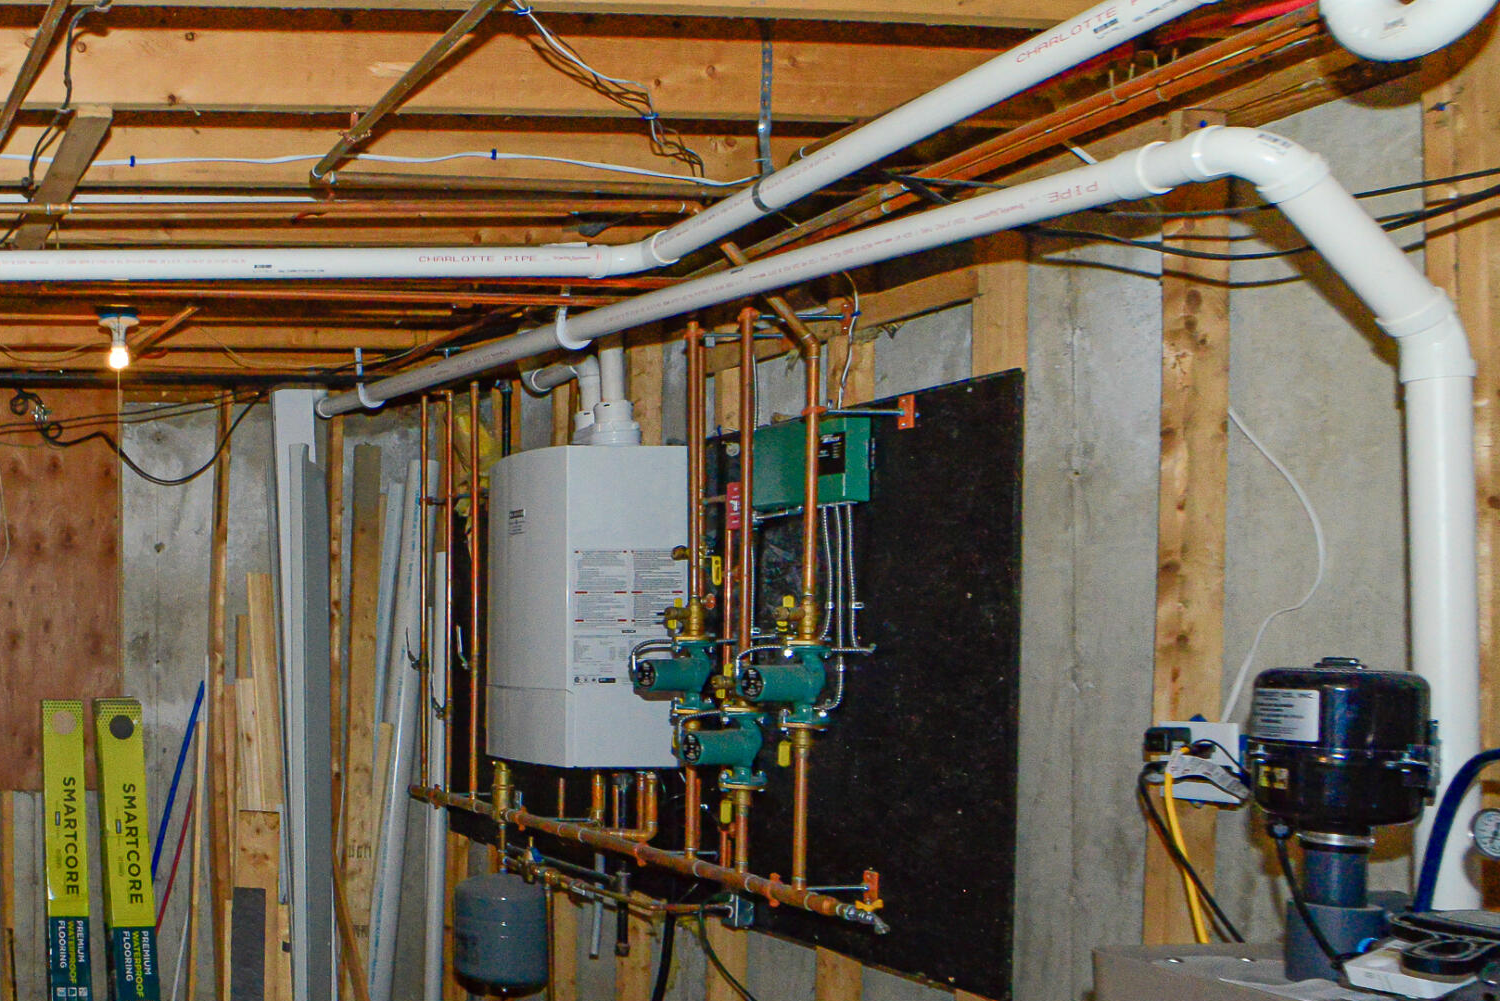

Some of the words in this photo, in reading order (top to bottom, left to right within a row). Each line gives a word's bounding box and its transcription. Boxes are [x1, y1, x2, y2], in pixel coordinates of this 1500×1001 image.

[1015, 6, 1118, 64] CHARLOTTE
[1048, 181, 1099, 203] PIPE
[418, 255, 495, 263] CHARLOTTE
[503, 255, 538, 263] PIPE
[62, 776, 80, 896] SMARTCORE
[122, 783, 144, 905] SMARTCORE
[57, 920, 68, 969] FLOORING
[67, 920, 77, 984] WATERPROOF
[76, 920, 85, 963] PREMIUM
[122, 930, 134, 982] FLOORING
[131, 930, 145, 999] WATERPROOF
[140, 930, 152, 976] PREMIUM
